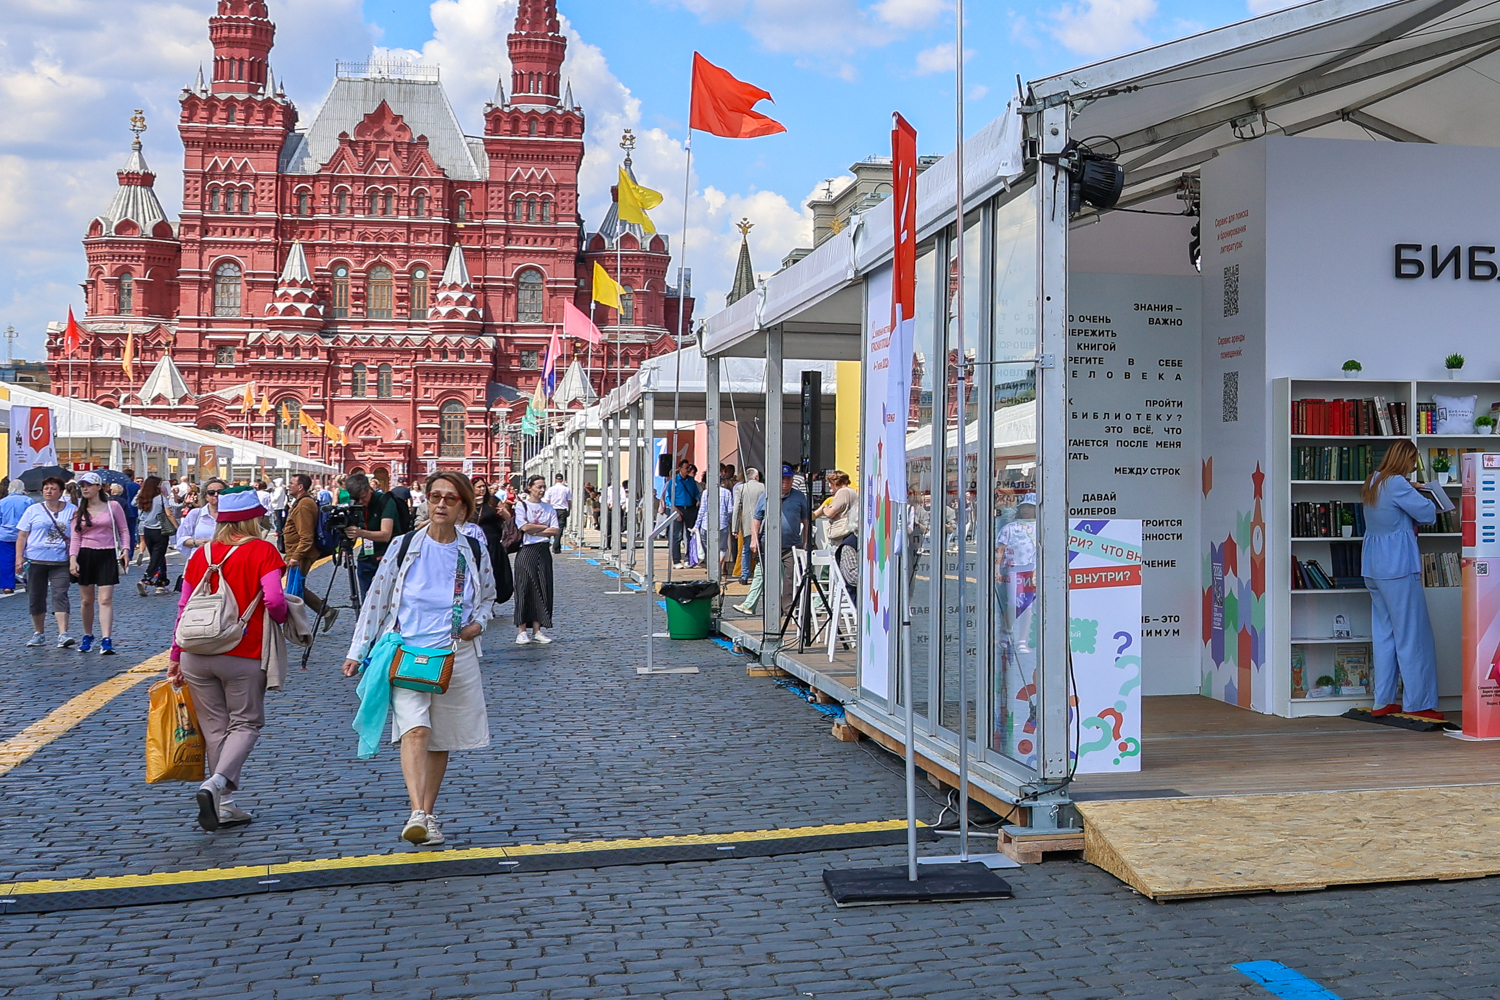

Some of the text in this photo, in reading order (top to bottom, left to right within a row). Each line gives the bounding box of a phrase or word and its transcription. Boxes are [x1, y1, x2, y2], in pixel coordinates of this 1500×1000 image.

[1133, 303, 1173, 312] ЗНАНИЯ
[1078, 315, 1112, 324] ОЧЕНЬ
[1148, 318, 1183, 326] ВАЖНО
[1077, 342, 1116, 351] КНИГОЙ
[1158, 359, 1183, 367] СЕБЕ
[1145, 399, 1183, 408] ПРОЙТИ
[1072, 412, 1182, 421] БИБЛИОТЕКУ?
[31, 414, 44, 440] 6
[1133, 425, 1154, 435] ВСЁ,
[204, 449, 214, 466] 5
[1114, 467, 1148, 476] МЕЖДУ
[1082, 492, 1117, 502] ДАВАЙ
[1101, 543, 1123, 558] ЧТО
[1075, 571, 1131, 584] ВНУТРИ?
